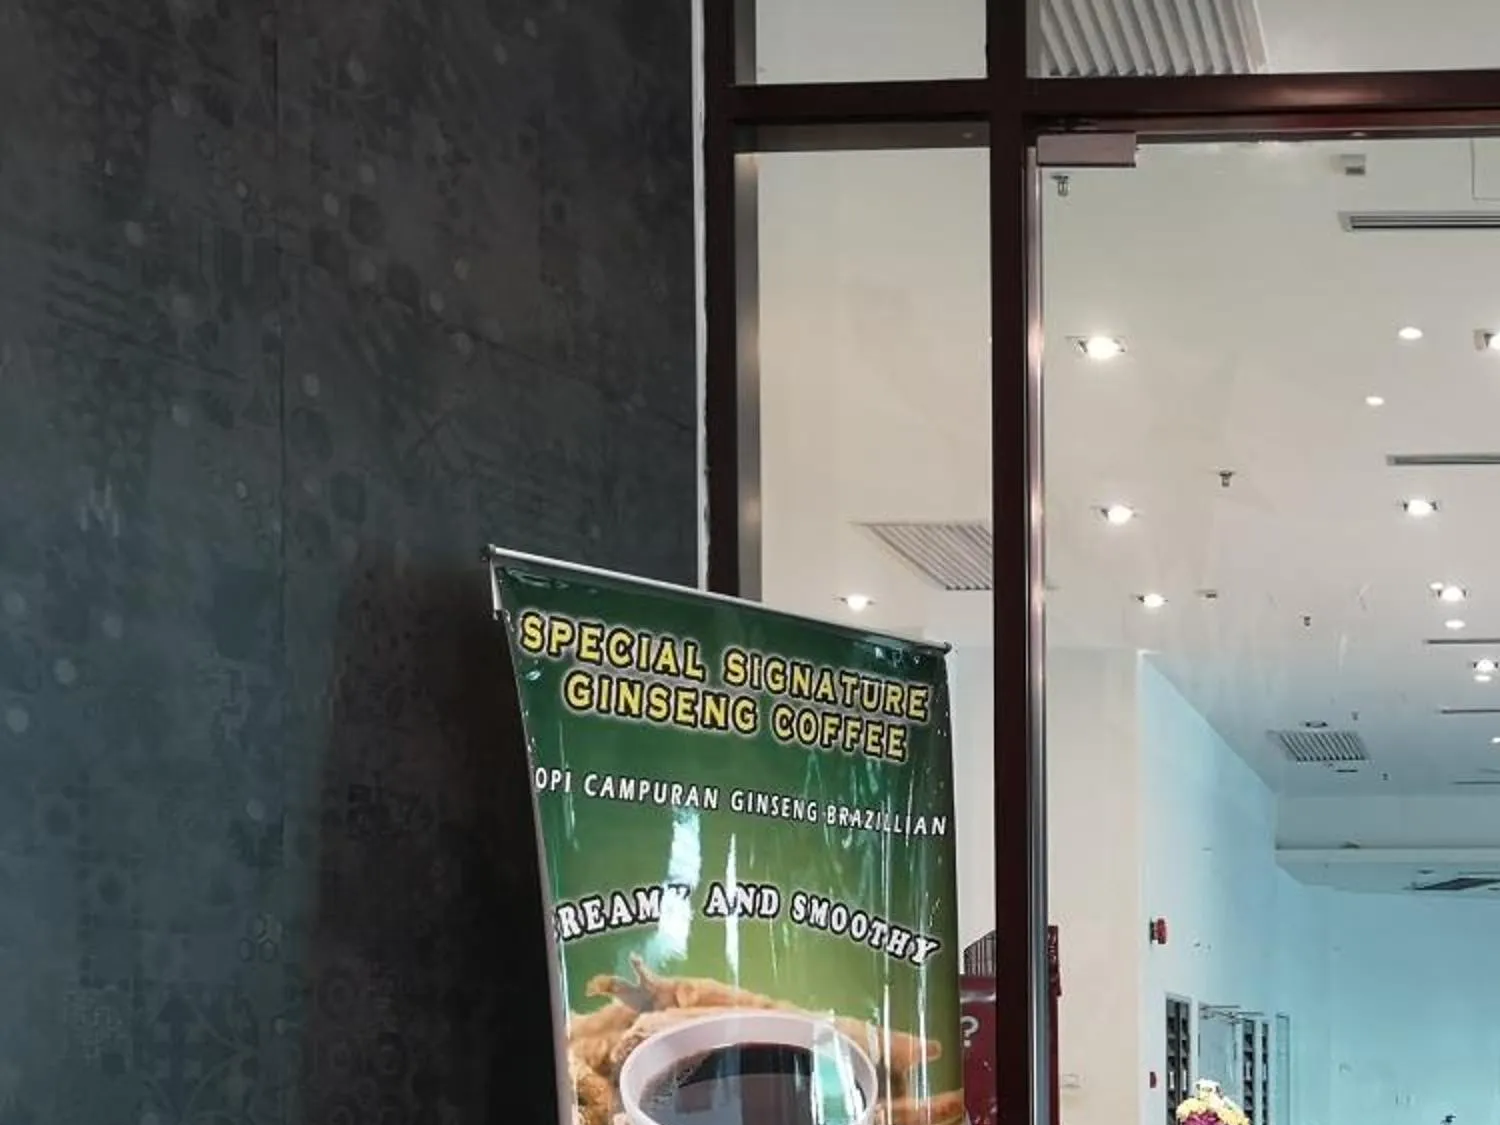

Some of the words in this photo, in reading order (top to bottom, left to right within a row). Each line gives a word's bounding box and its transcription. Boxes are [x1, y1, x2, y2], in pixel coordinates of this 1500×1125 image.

[520, 611, 704, 681] SPECIAL
[724, 648, 931, 721] SIGNATURE
[564, 673, 758, 733] GINSENG
[772, 704, 908, 761] COFFEE
[534, 767, 571, 793] OPI
[584, 773, 718, 808] CAMPURAN
[731, 791, 818, 822] GINSENG
[826, 806, 946, 835] BRAZILLIAN
[553, 883, 691, 941] REAM
[705, 883, 780, 917] AND
[791, 893, 941, 964] SMOOTHY
